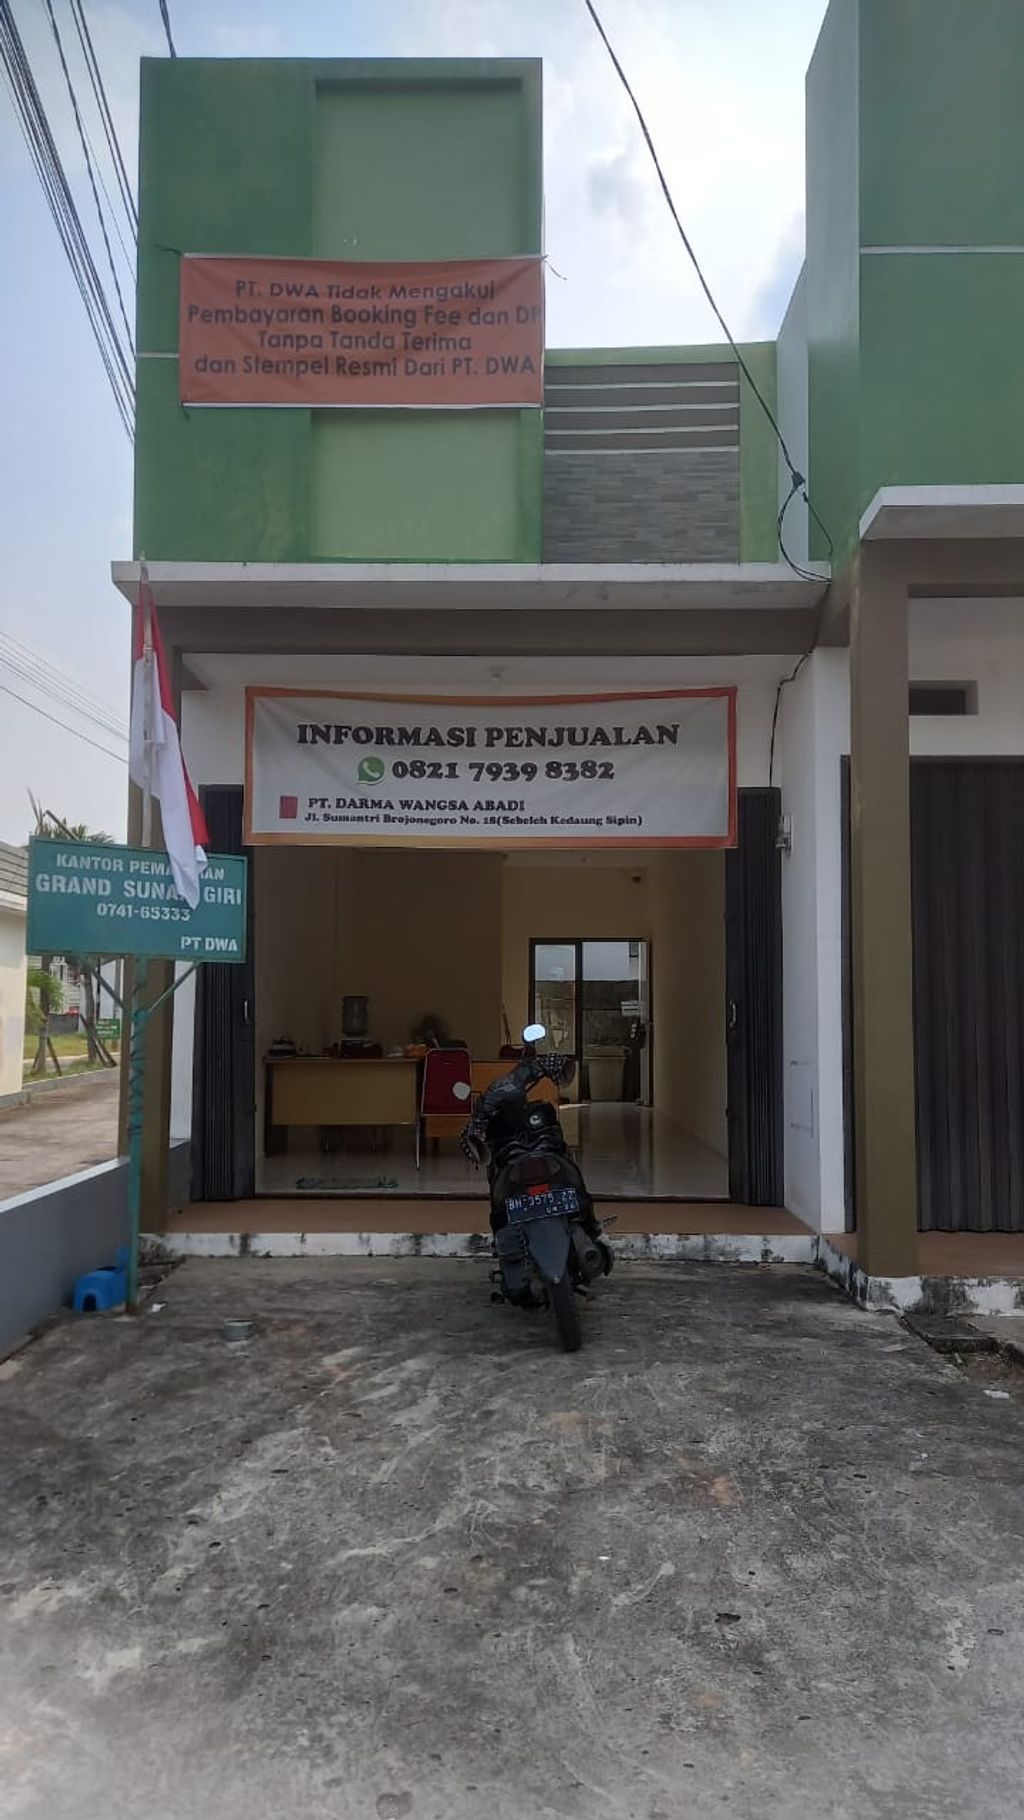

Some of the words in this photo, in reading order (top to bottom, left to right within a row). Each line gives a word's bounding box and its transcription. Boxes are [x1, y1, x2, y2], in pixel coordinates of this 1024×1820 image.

[236, 280, 261, 297] PT.
[270, 283, 319, 298] DWA
[328, 284, 381, 299] Tidak
[389, 281, 495, 302] Mengakui
[188, 305, 324, 326] Pembayaran
[331, 305, 416, 328] Booking
[424, 305, 461, 325] Fee
[468, 307, 508, 325] dan
[259, 330, 323, 351] Tanpa
[330, 331, 395, 349] Tanda
[402, 332, 472, 351] Terima
[194, 355, 236, 374] dan
[243, 355, 329, 376] Stempel
[336, 356, 397, 376] Resmi
[404, 358, 445, 376] Dari
[452, 357, 479, 376] PT.
[486, 356, 536, 375] DWA
[296, 723, 478, 748] INFORMASI
[484, 724, 680, 748] PENJUALAN
[392, 760, 459, 781] 0821
[468, 761, 538, 782] 7939
[544, 761, 615, 781] 8382
[308, 797, 331, 809] PT.
[335, 798, 395, 810] DARMA
[399, 799, 469, 811] WANGSA
[473, 800, 525, 811] ABADI
[323, 813, 380, 823] Sumantri
[382, 814, 457, 826] Brojonegoro
[460, 815, 480, 825] No.
[550, 815, 603, 827] Kedaung
[605, 815, 643, 827] Sipin)
[56, 853, 124, 872] KANTOR
[35, 872, 112, 896] GRAND
[123, 880, 188, 901] SUNA
[203, 886, 242, 905] GIRI
[97, 903, 191, 922] 0741-65333
[181, 936, 202, 950] PT
[204, 937, 238, 951] DWA
